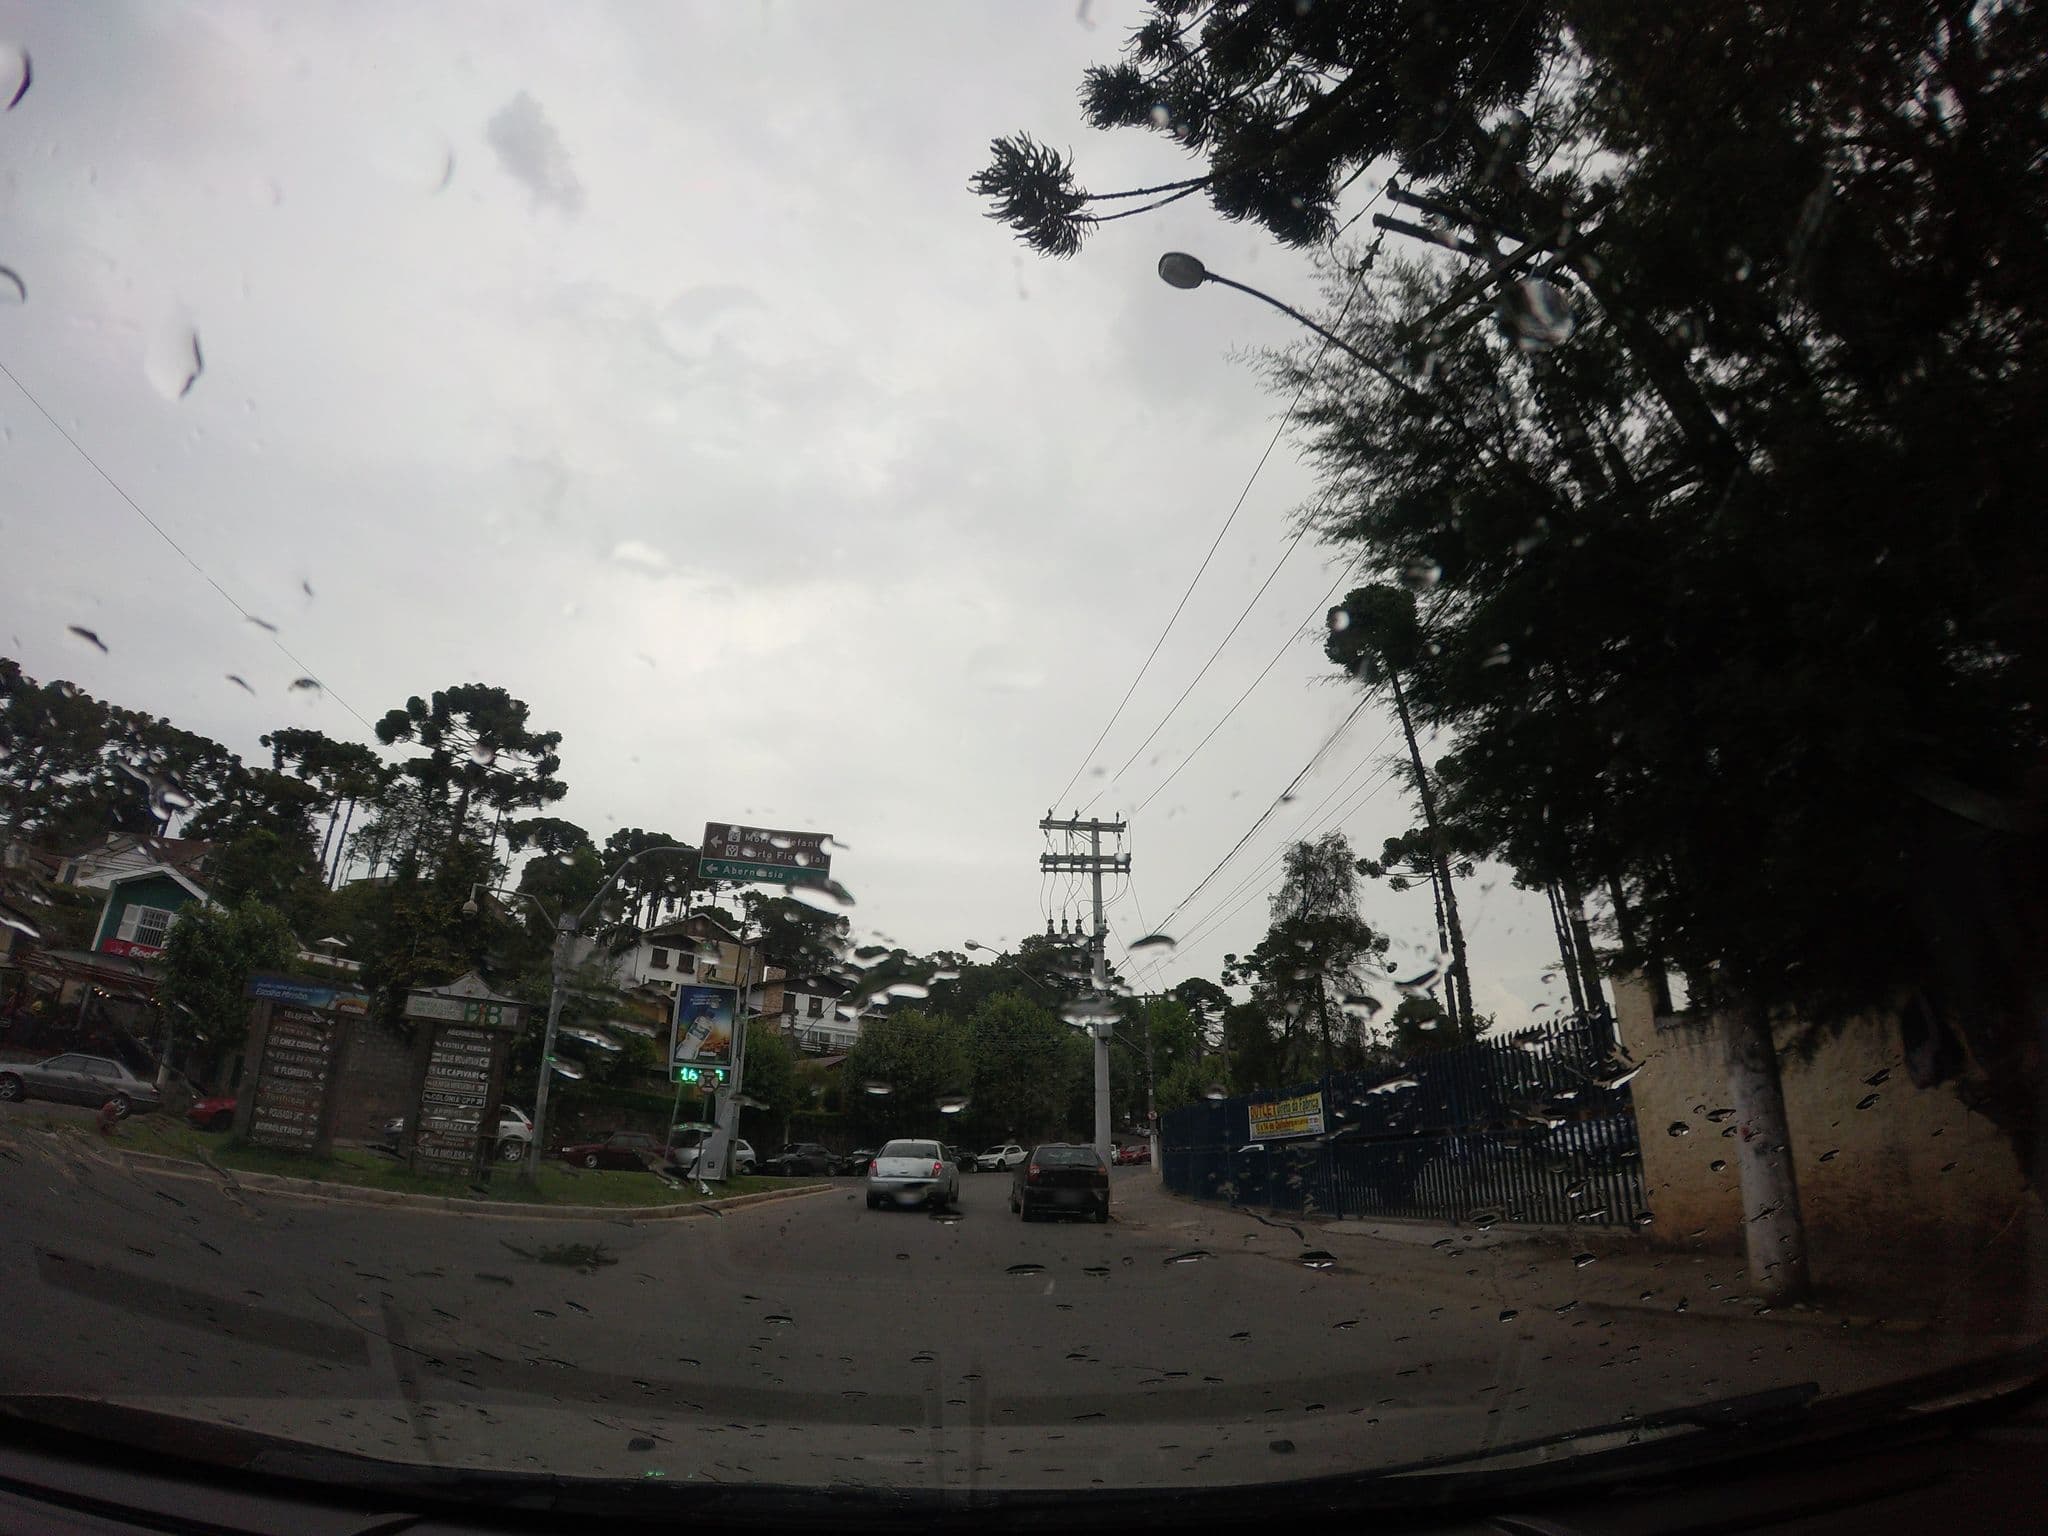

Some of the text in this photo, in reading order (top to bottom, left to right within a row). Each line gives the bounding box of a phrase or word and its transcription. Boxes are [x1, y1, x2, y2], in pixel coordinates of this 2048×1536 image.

[742, 847, 826, 864] orto Flotal
[723, 865, 784, 879] Abernsia
